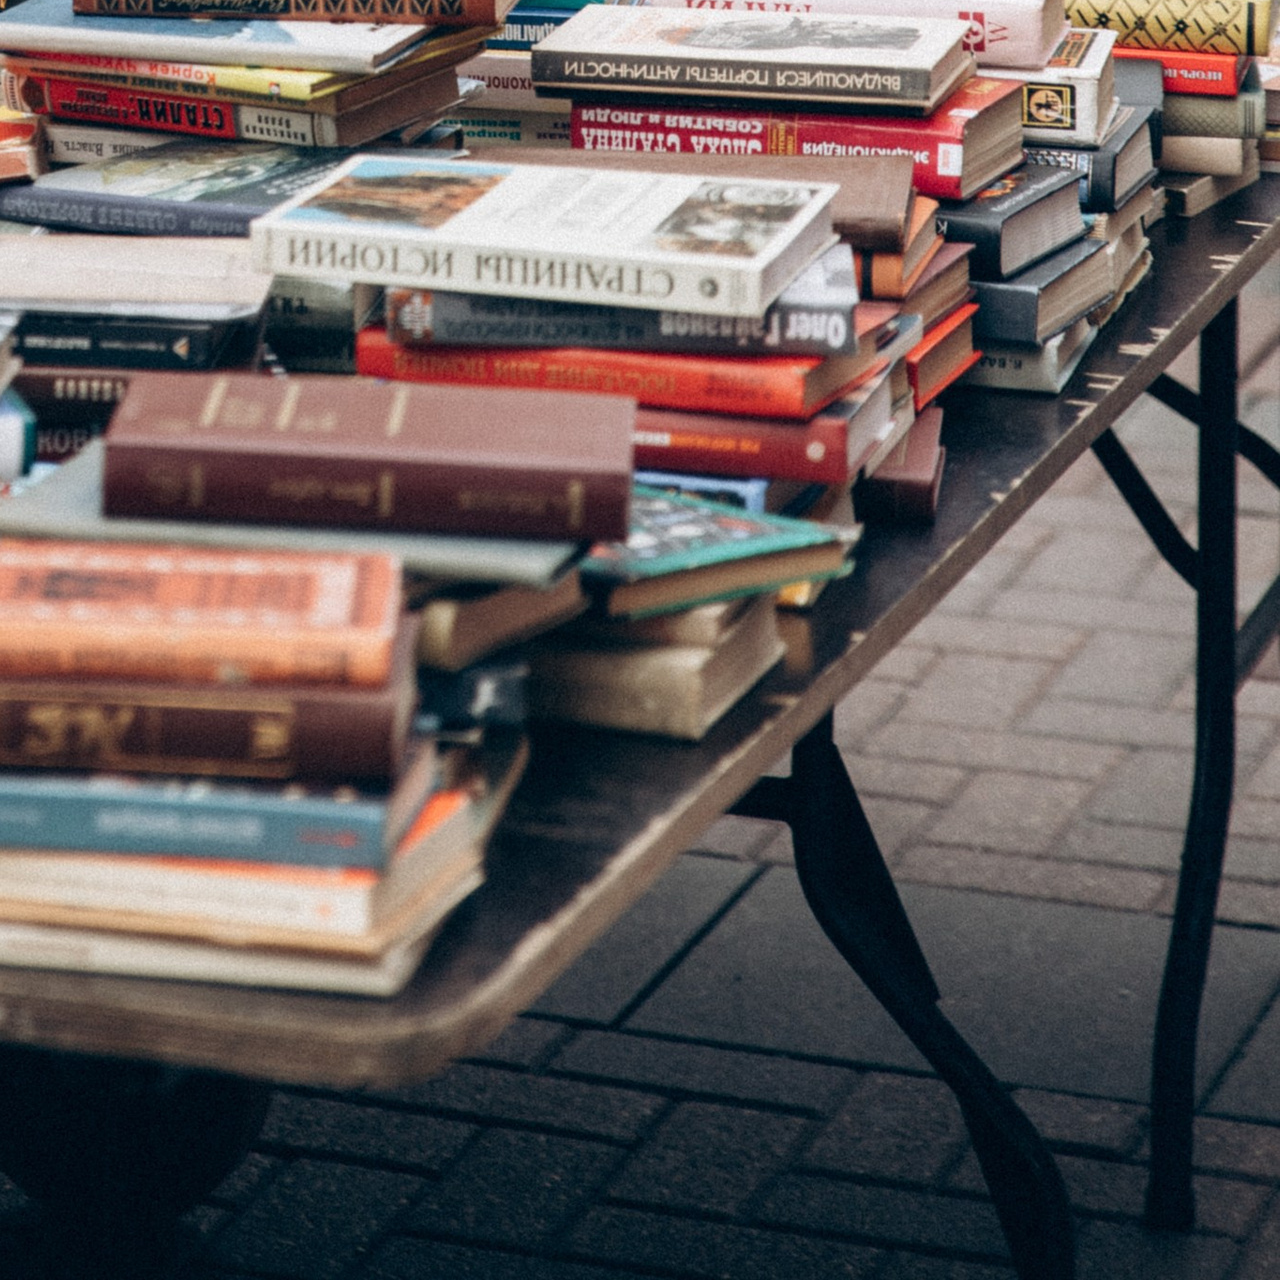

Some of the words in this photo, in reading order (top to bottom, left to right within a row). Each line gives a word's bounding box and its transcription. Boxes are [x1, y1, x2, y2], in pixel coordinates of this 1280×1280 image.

[148, 64, 217, 87] Корней
[564, 60, 681, 83] АНТИЧНОСТИ
[685, 65, 769, 86] ПОРТРЕТЫ
[775, 68, 901, 91] ВЫДАЮЩИЕСЯ
[580, 108, 647, 125] ЛЮДИ
[665, 113, 763, 134] СОБЫТИЯ
[464, 129, 521, 141] Вопро
[60, 140, 104, 157] Власть.
[289, 239, 454, 279] ИСТОРИИ
[475, 254, 674, 298] СТРАНИЦЫ
[785, 312, 847, 349] Олег
